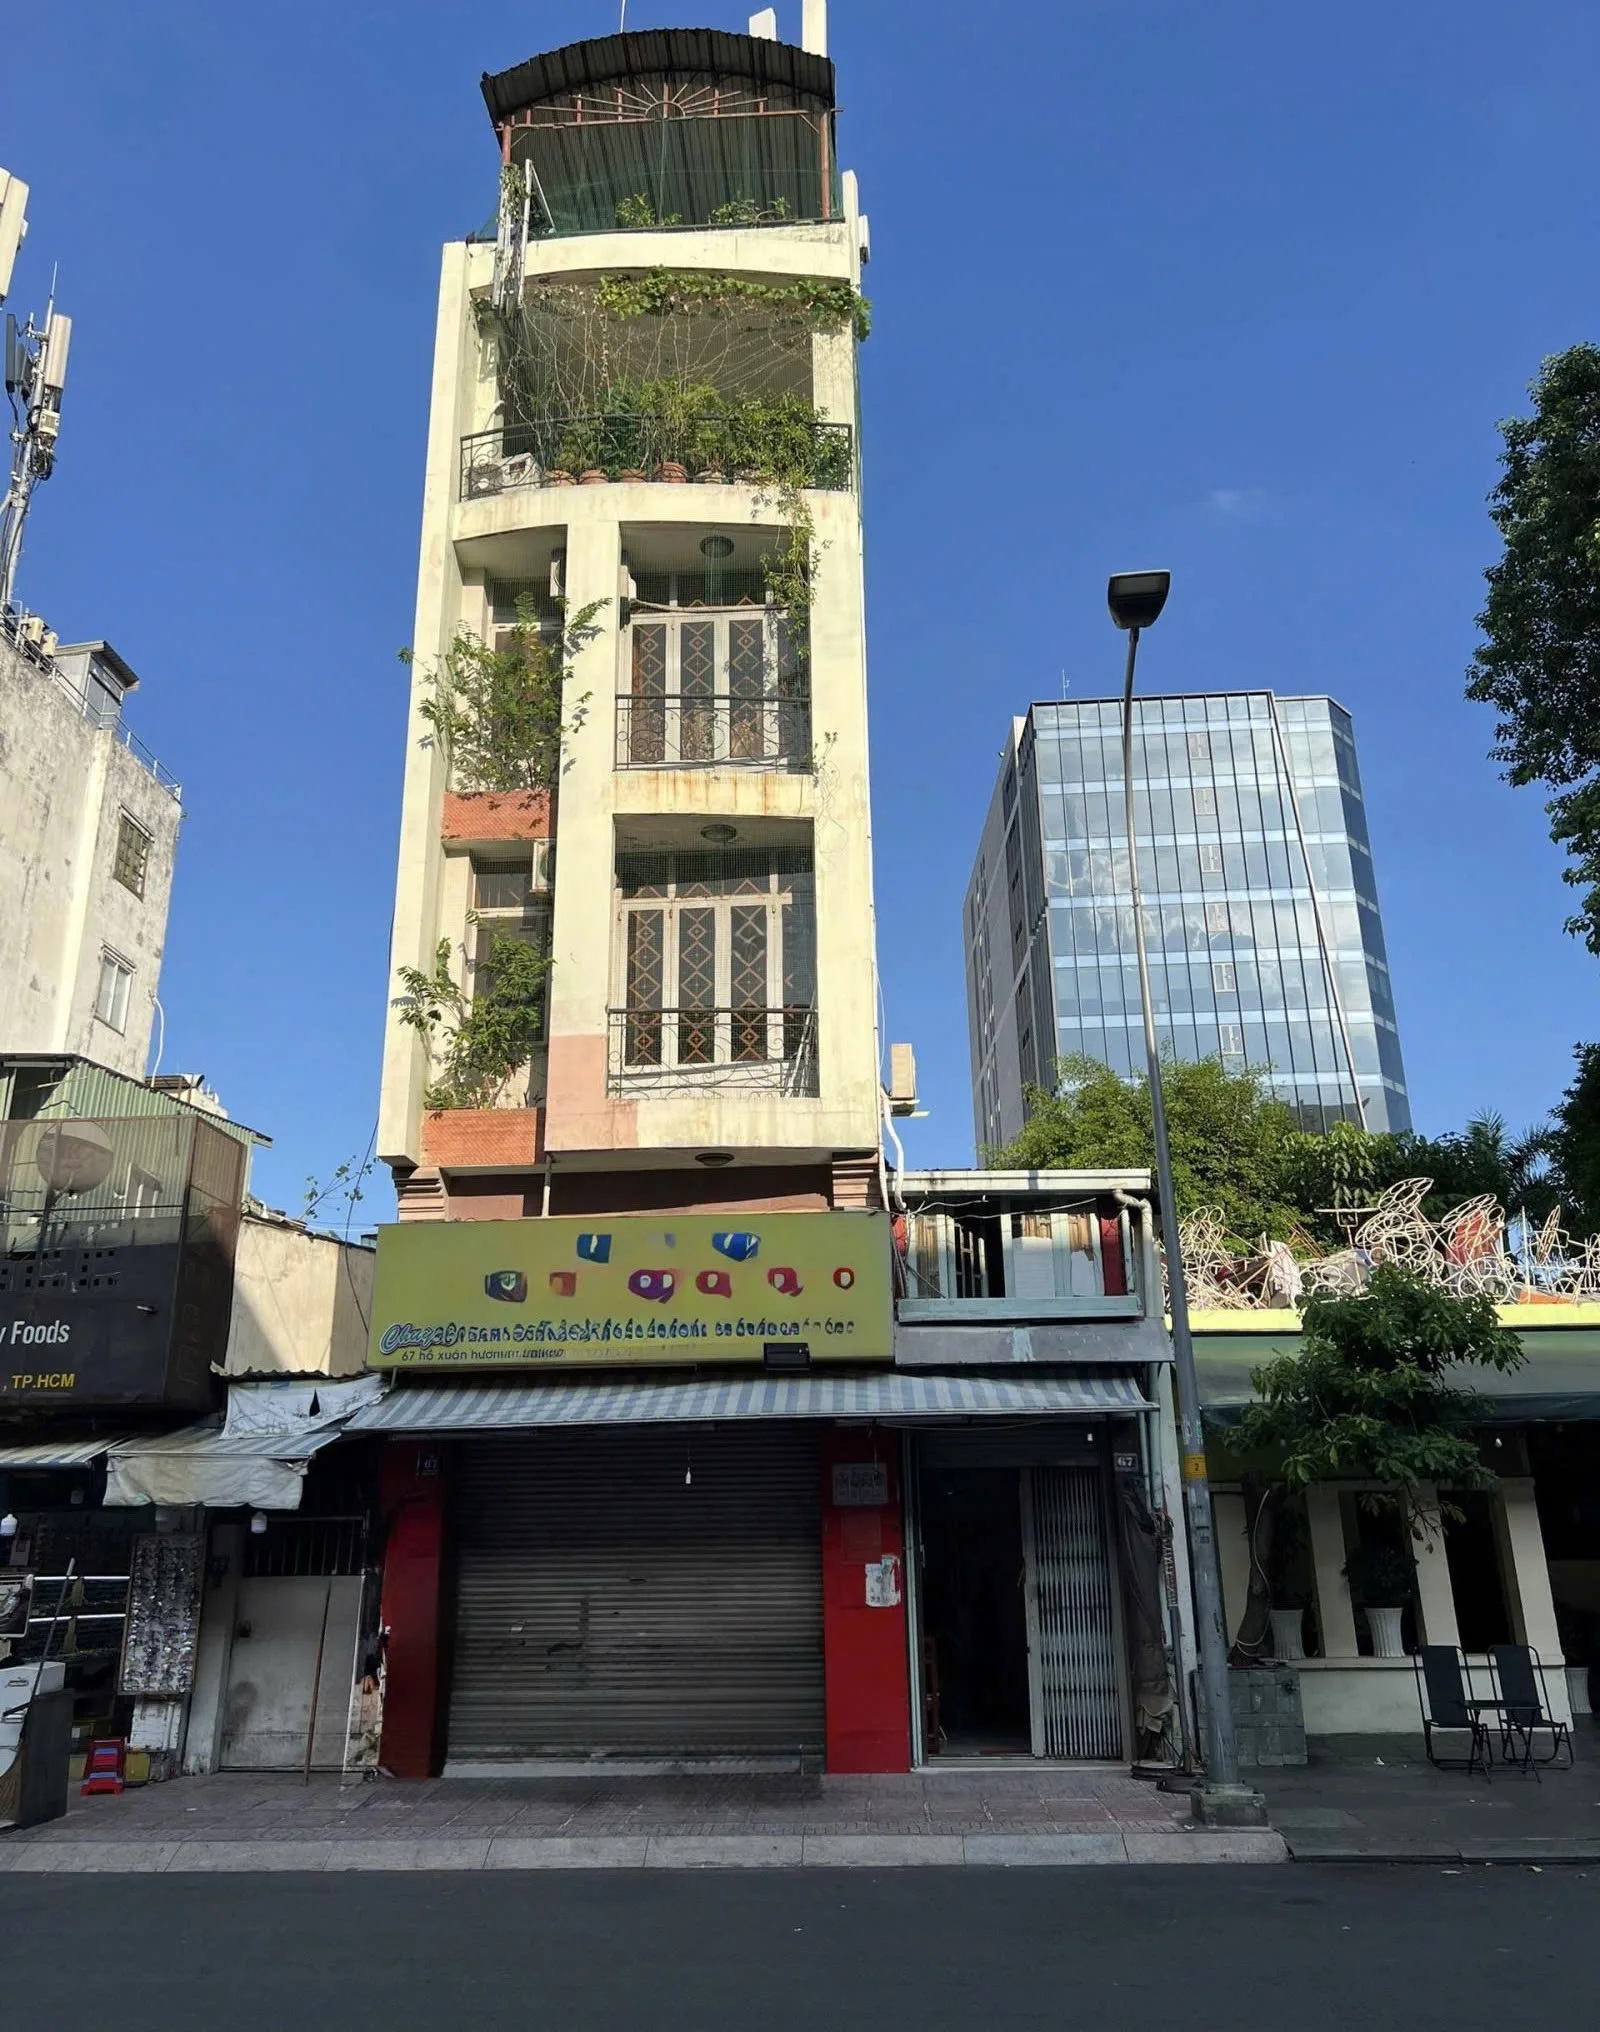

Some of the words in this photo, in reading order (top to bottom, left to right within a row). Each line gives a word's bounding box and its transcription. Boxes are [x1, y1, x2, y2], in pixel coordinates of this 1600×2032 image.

[11, 1320, 70, 1344] Foods
[402, 1350, 415, 1361] 67
[11, 1373, 75, 1389] TP.HCM
[1117, 1456, 1133, 1467] 67
